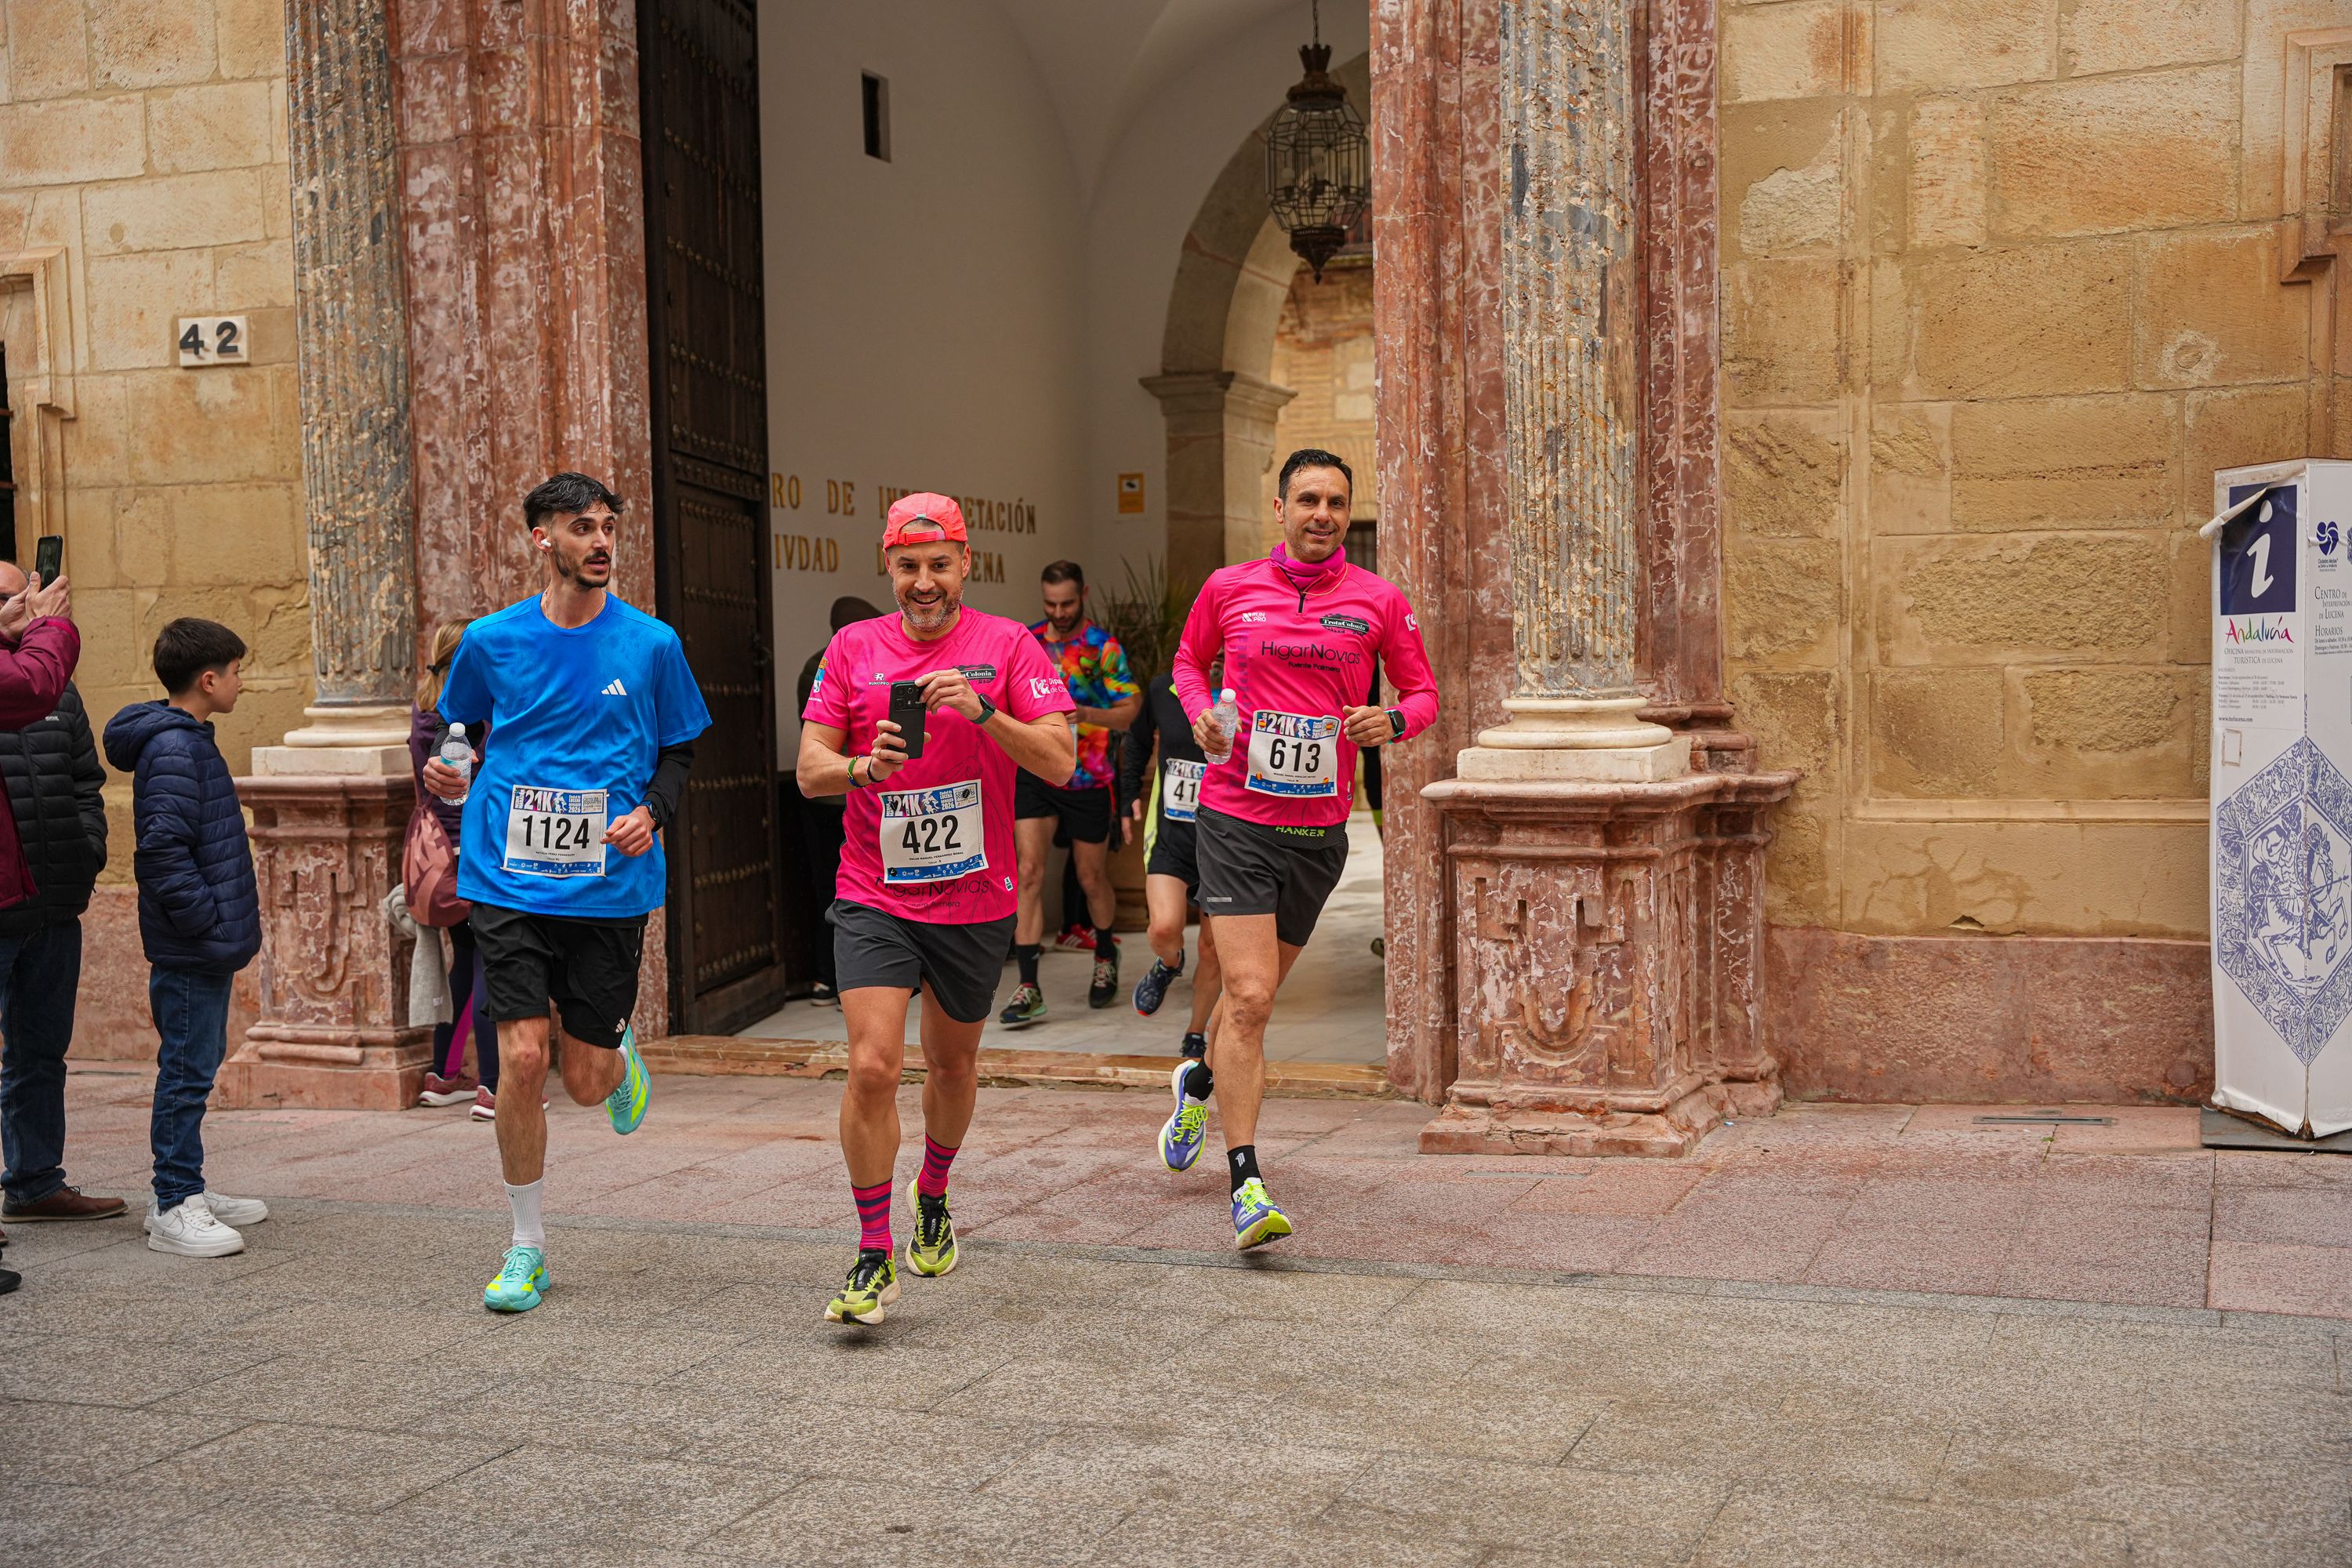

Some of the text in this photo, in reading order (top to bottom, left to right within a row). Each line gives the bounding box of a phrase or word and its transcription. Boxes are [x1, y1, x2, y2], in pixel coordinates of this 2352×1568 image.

[179, 321, 238, 355] 42
[827, 479, 855, 516] DE
[878, 485, 1036, 535] IETACIÓN
[971, 550, 1005, 584] ENA
[2314, 586, 2340, 600] CENTRO
[2325, 608, 2344, 619] LUCENA
[2315, 625, 2343, 637] HORARIOS
[1261, 641, 1360, 664] HigarNovias
[1288, 661, 1341, 673] Fuente Palmera
[1267, 713, 1296, 736] 21K
[1269, 738, 1321, 773] 613
[524, 789, 553, 813] 21K
[894, 794, 923, 816] 21K
[942, 801, 955, 811] 2026
[522, 815, 590, 850] 1124
[902, 815, 961, 854] 422
[1276, 825, 1325, 837] HANKER
[875, 877, 989, 898] garNovias
